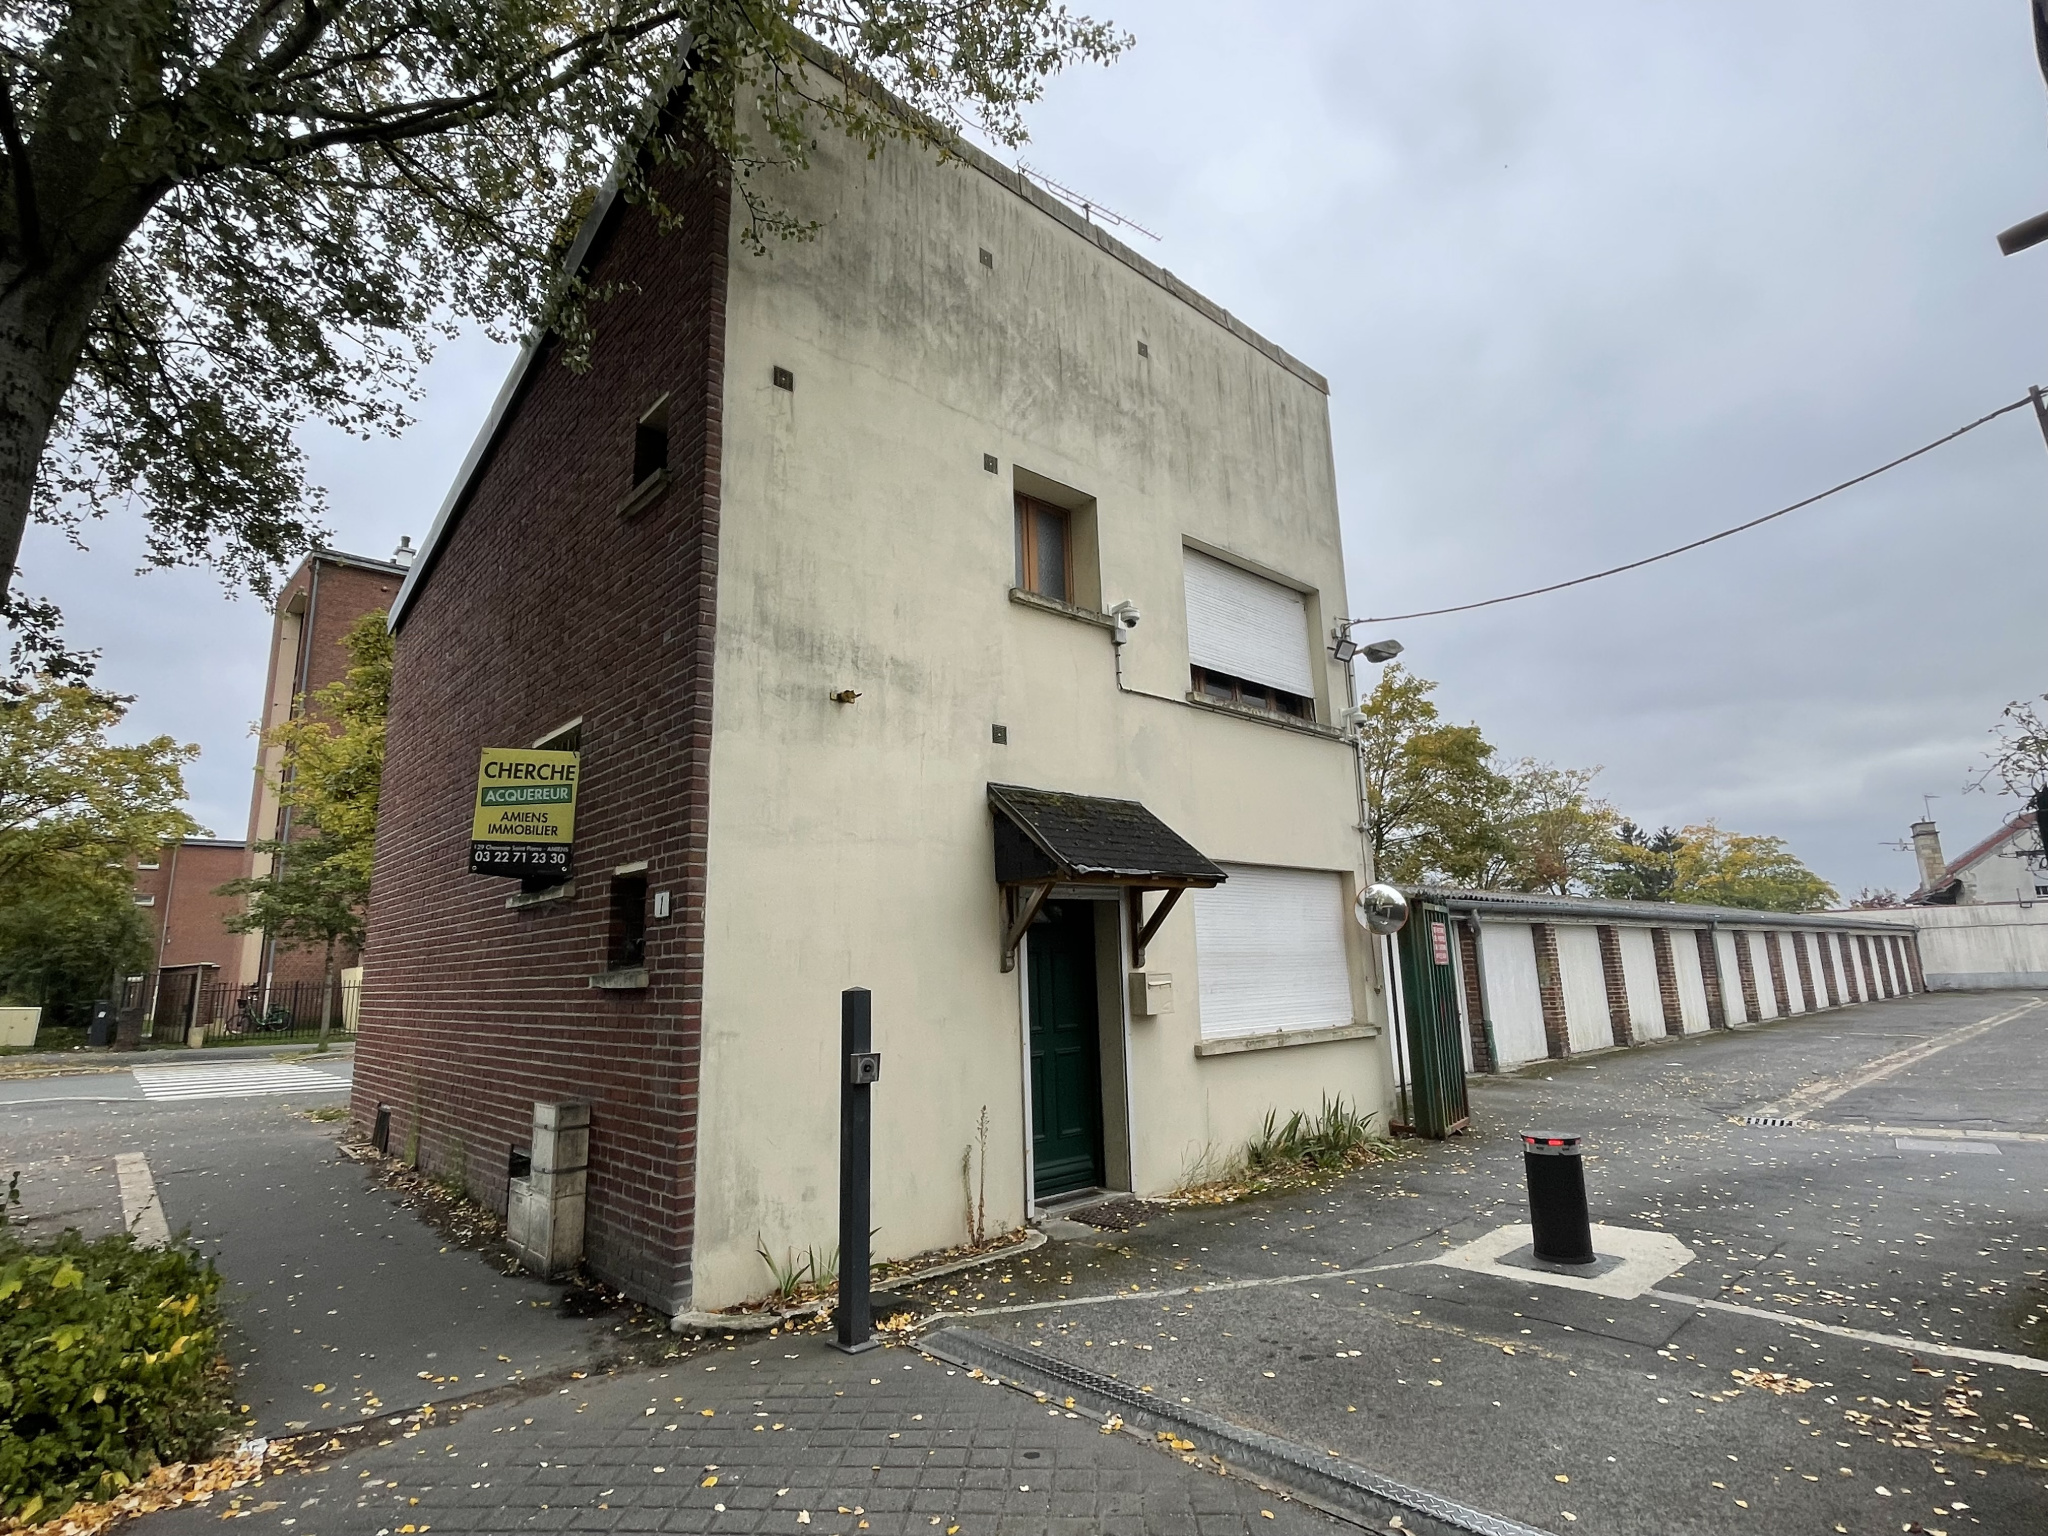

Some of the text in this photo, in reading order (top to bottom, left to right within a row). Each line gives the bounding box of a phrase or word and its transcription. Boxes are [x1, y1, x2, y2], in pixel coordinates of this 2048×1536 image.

[484, 761, 576, 781] CHERCHE
[485, 787, 569, 802] ACQUEREUR
[500, 811, 549, 824] AMIENS
[488, 824, 558, 836] IMMOBILIER
[474, 851, 565, 864] 03 22 71 23 30
